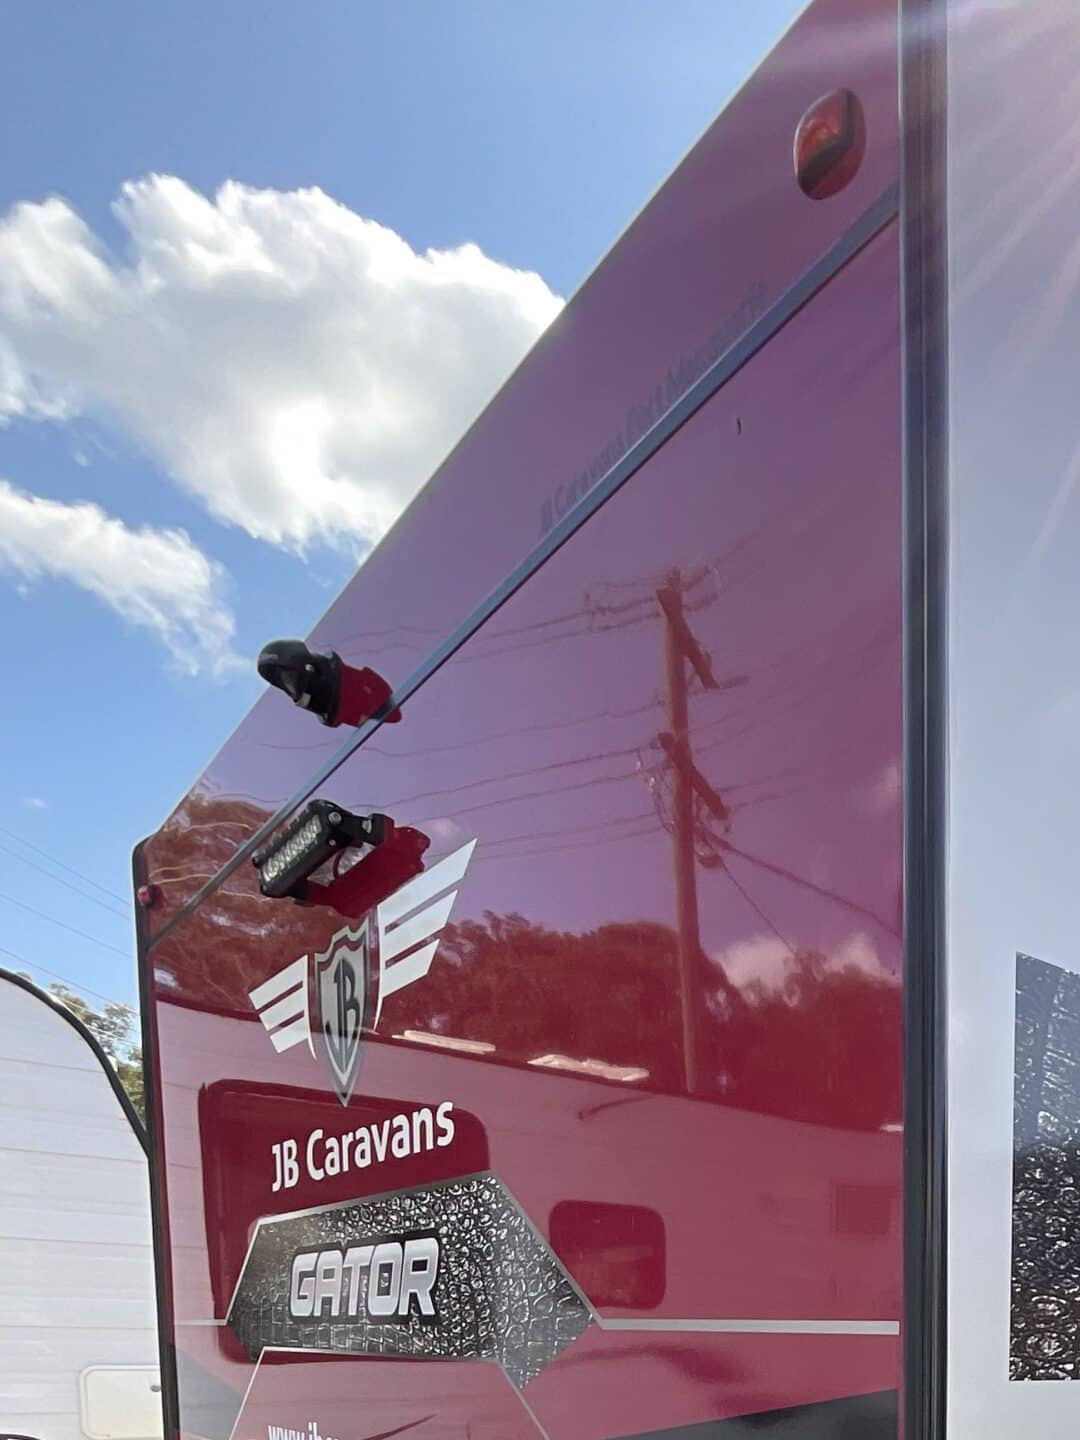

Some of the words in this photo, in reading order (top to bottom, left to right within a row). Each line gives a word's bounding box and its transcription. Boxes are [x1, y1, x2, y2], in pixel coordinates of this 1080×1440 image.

[271, 1138, 300, 1192] JB
[306, 1101, 455, 1181] Caravans
[289, 1236, 440, 1318] GATOR
